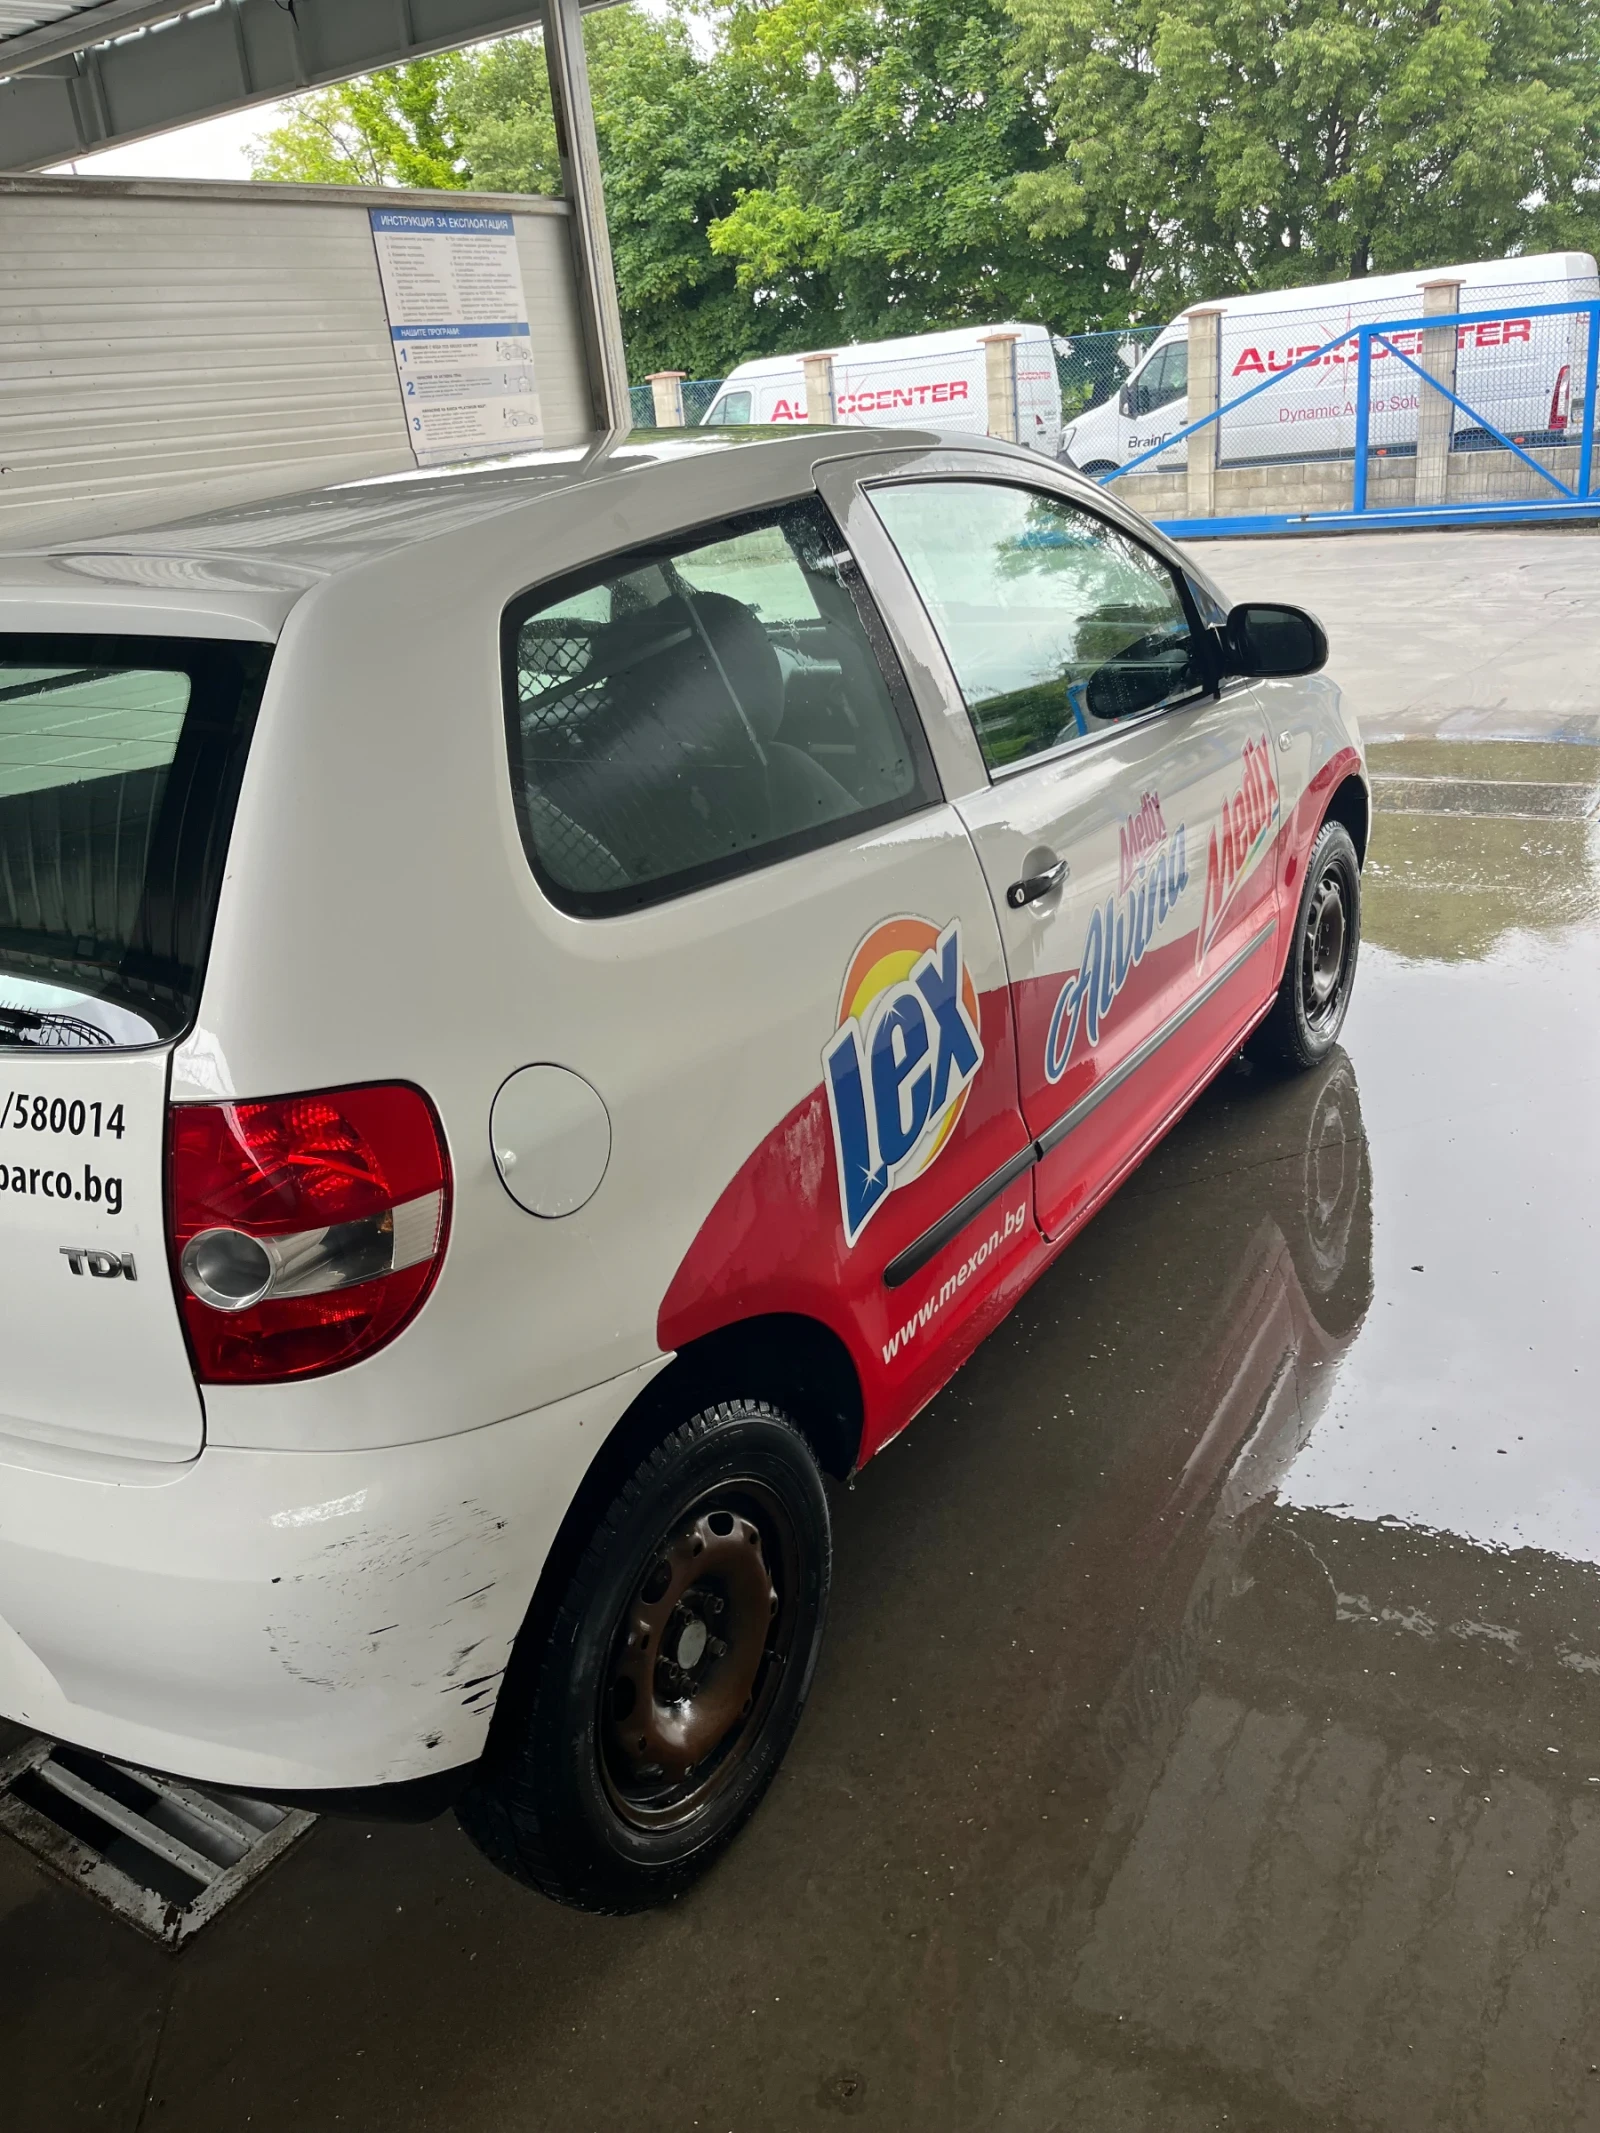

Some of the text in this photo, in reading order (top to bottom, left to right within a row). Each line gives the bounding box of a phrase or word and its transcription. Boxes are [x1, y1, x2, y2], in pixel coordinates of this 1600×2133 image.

[380, 216, 508, 229] ИНСТРУКЦИЯ ЗА ЕКСПЛОАТАЦИЯ
[400, 328, 427, 337] НАШИТЕ
[400, 348, 407, 362] 1
[406, 381, 416, 396] 2
[770, 380, 968, 422] AUOCENTER
[1279, 395, 1420, 424] Dynamic Aio Solu
[412, 417, 421, 431] 3
[59, 1245, 138, 1281] TDI
[882, 1201, 1027, 1365] www.mexon.bg
